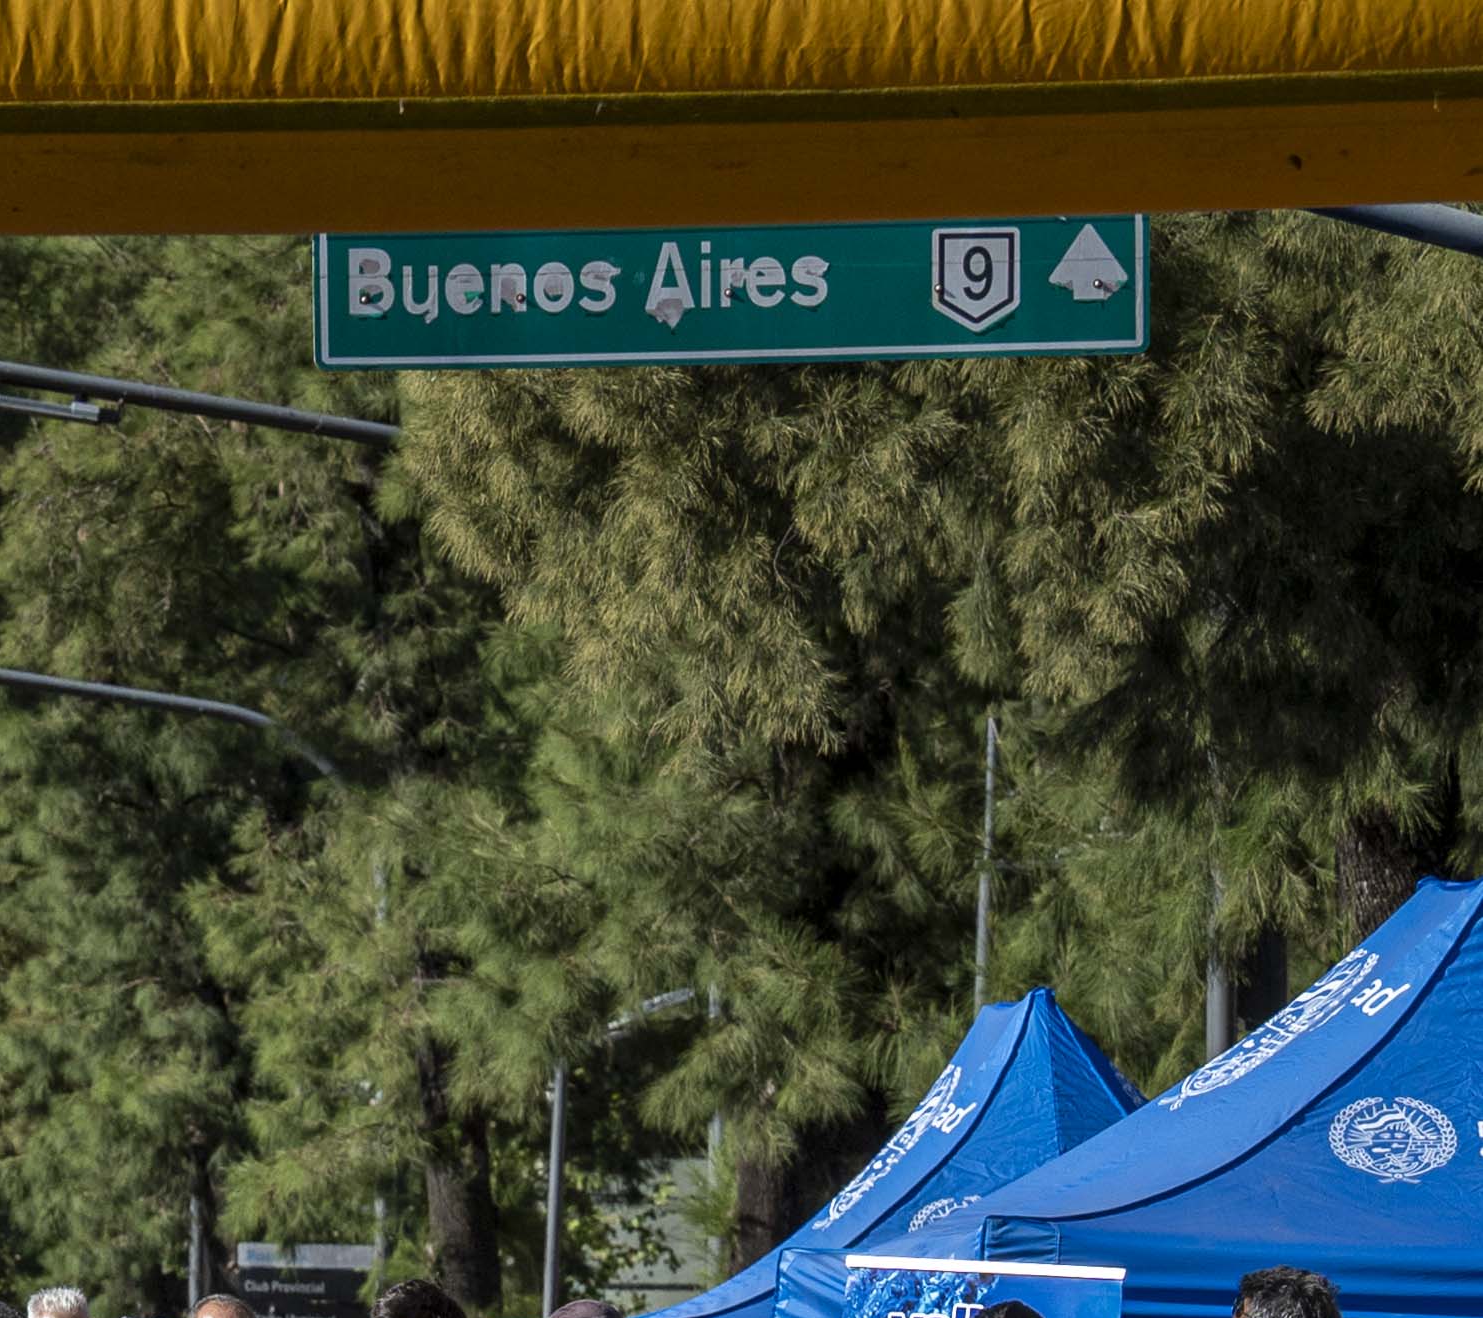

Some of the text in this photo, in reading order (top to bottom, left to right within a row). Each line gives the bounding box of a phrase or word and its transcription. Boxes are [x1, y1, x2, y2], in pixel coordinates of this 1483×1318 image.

[349, 241, 831, 324] Buenos Aires
[963, 245, 995, 300] 9
[271, 1280, 326, 1294] Provincial
